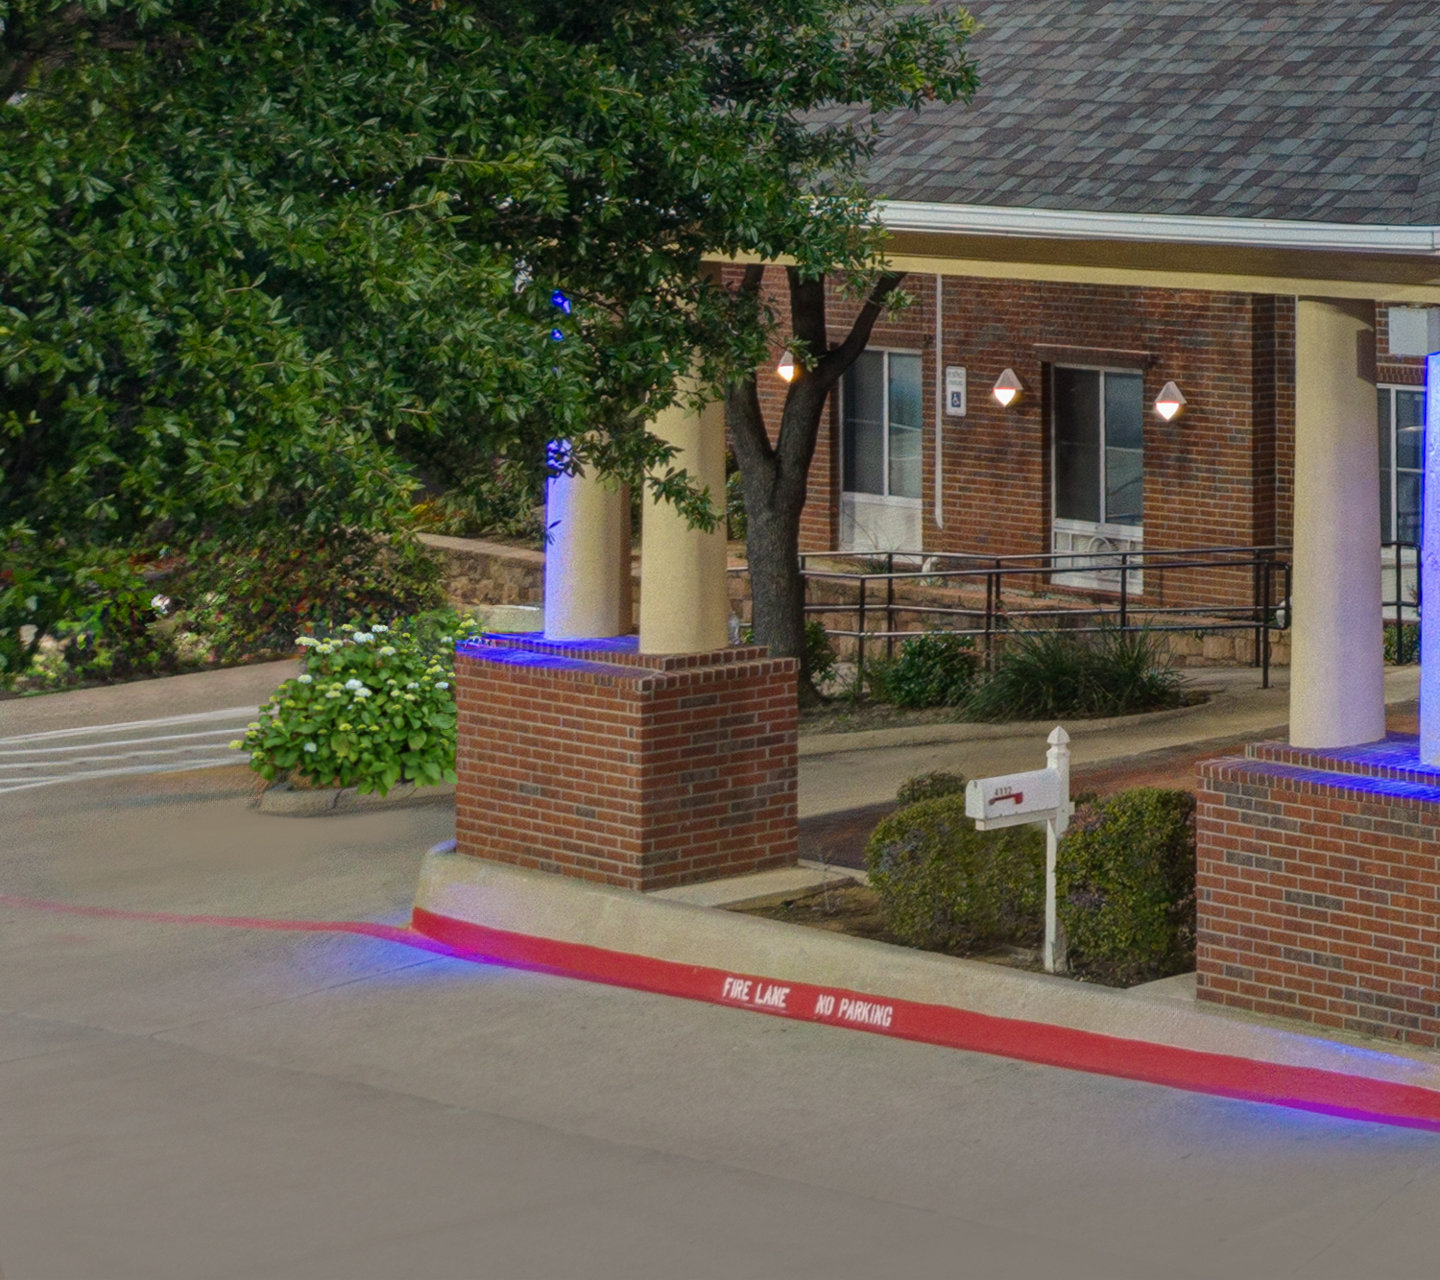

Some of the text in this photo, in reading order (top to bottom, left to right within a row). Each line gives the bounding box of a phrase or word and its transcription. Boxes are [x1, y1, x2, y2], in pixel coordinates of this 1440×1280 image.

[722, 977, 893, 1028] FIRE LANE NO PARKING
